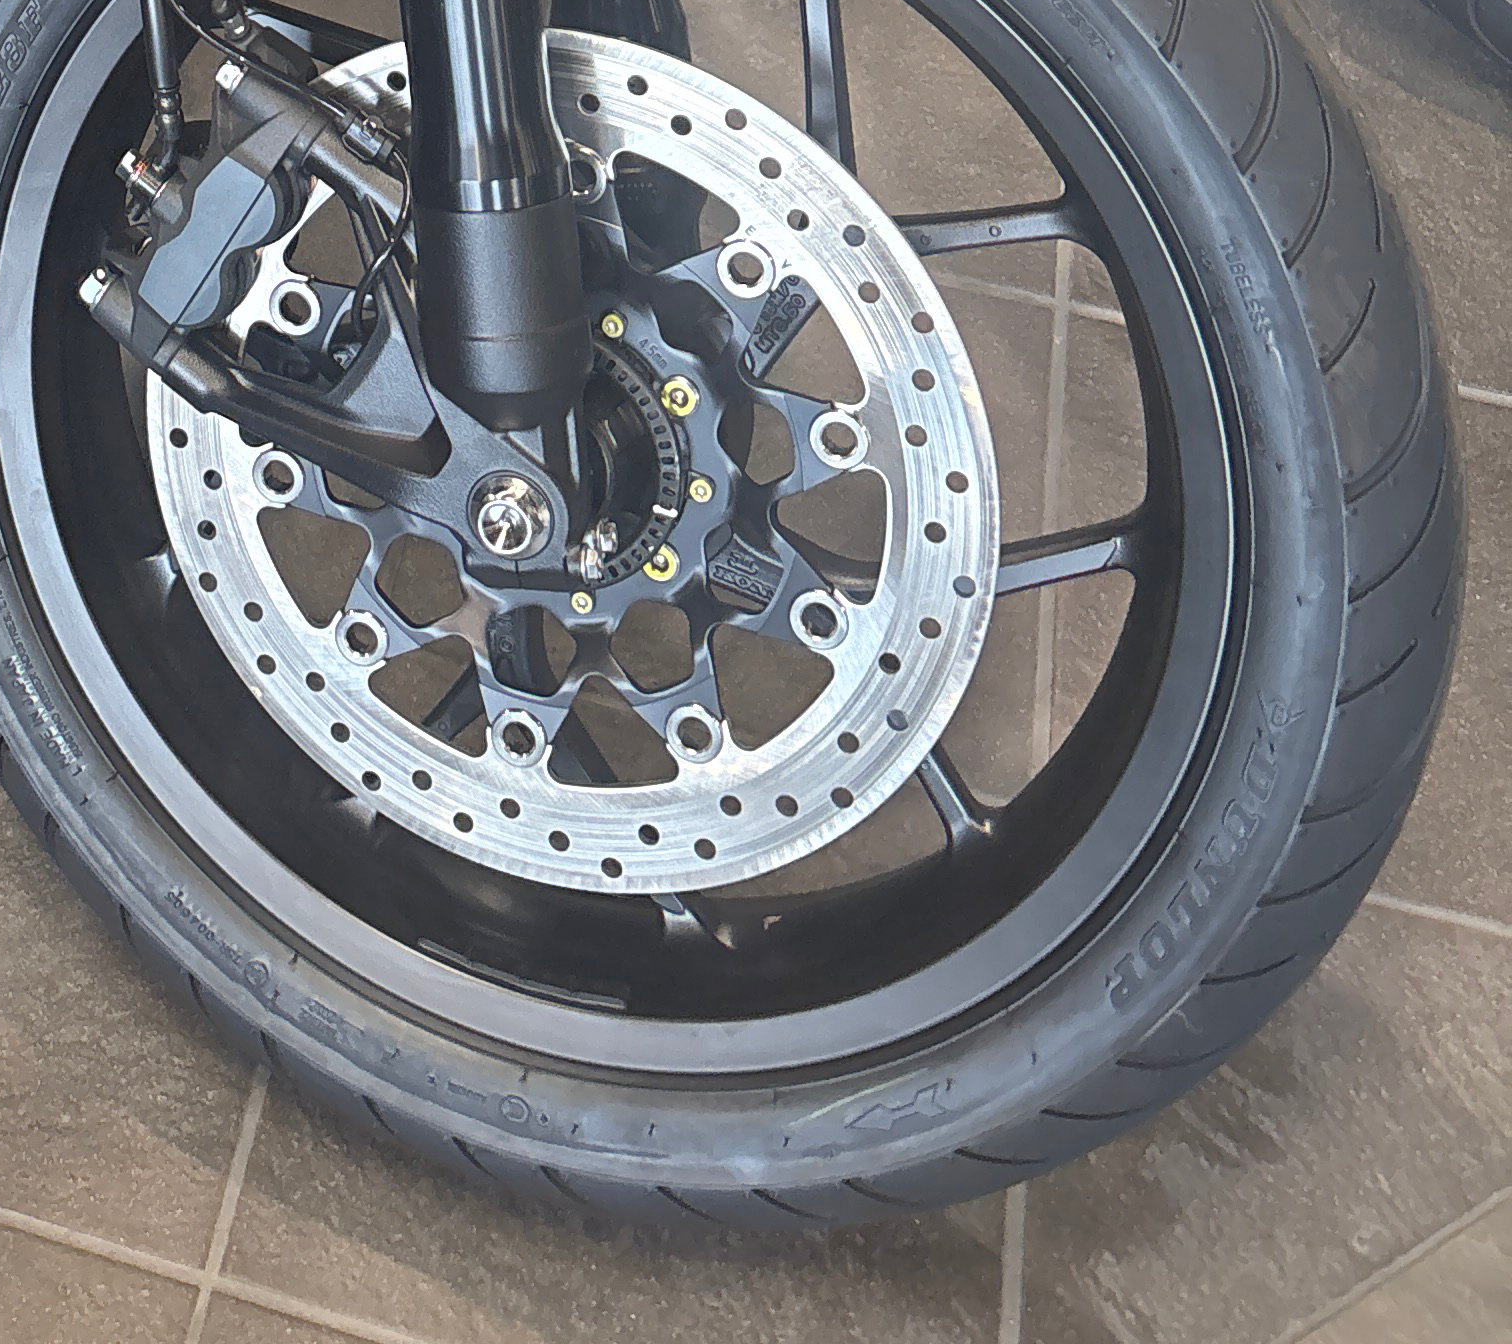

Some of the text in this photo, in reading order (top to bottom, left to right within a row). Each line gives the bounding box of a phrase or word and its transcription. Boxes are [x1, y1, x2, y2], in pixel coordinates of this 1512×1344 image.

[638, 338, 668, 370] 4.5mm
[2, 656, 35, 707] JAPAN
[39, 731, 73, 770] MADE
